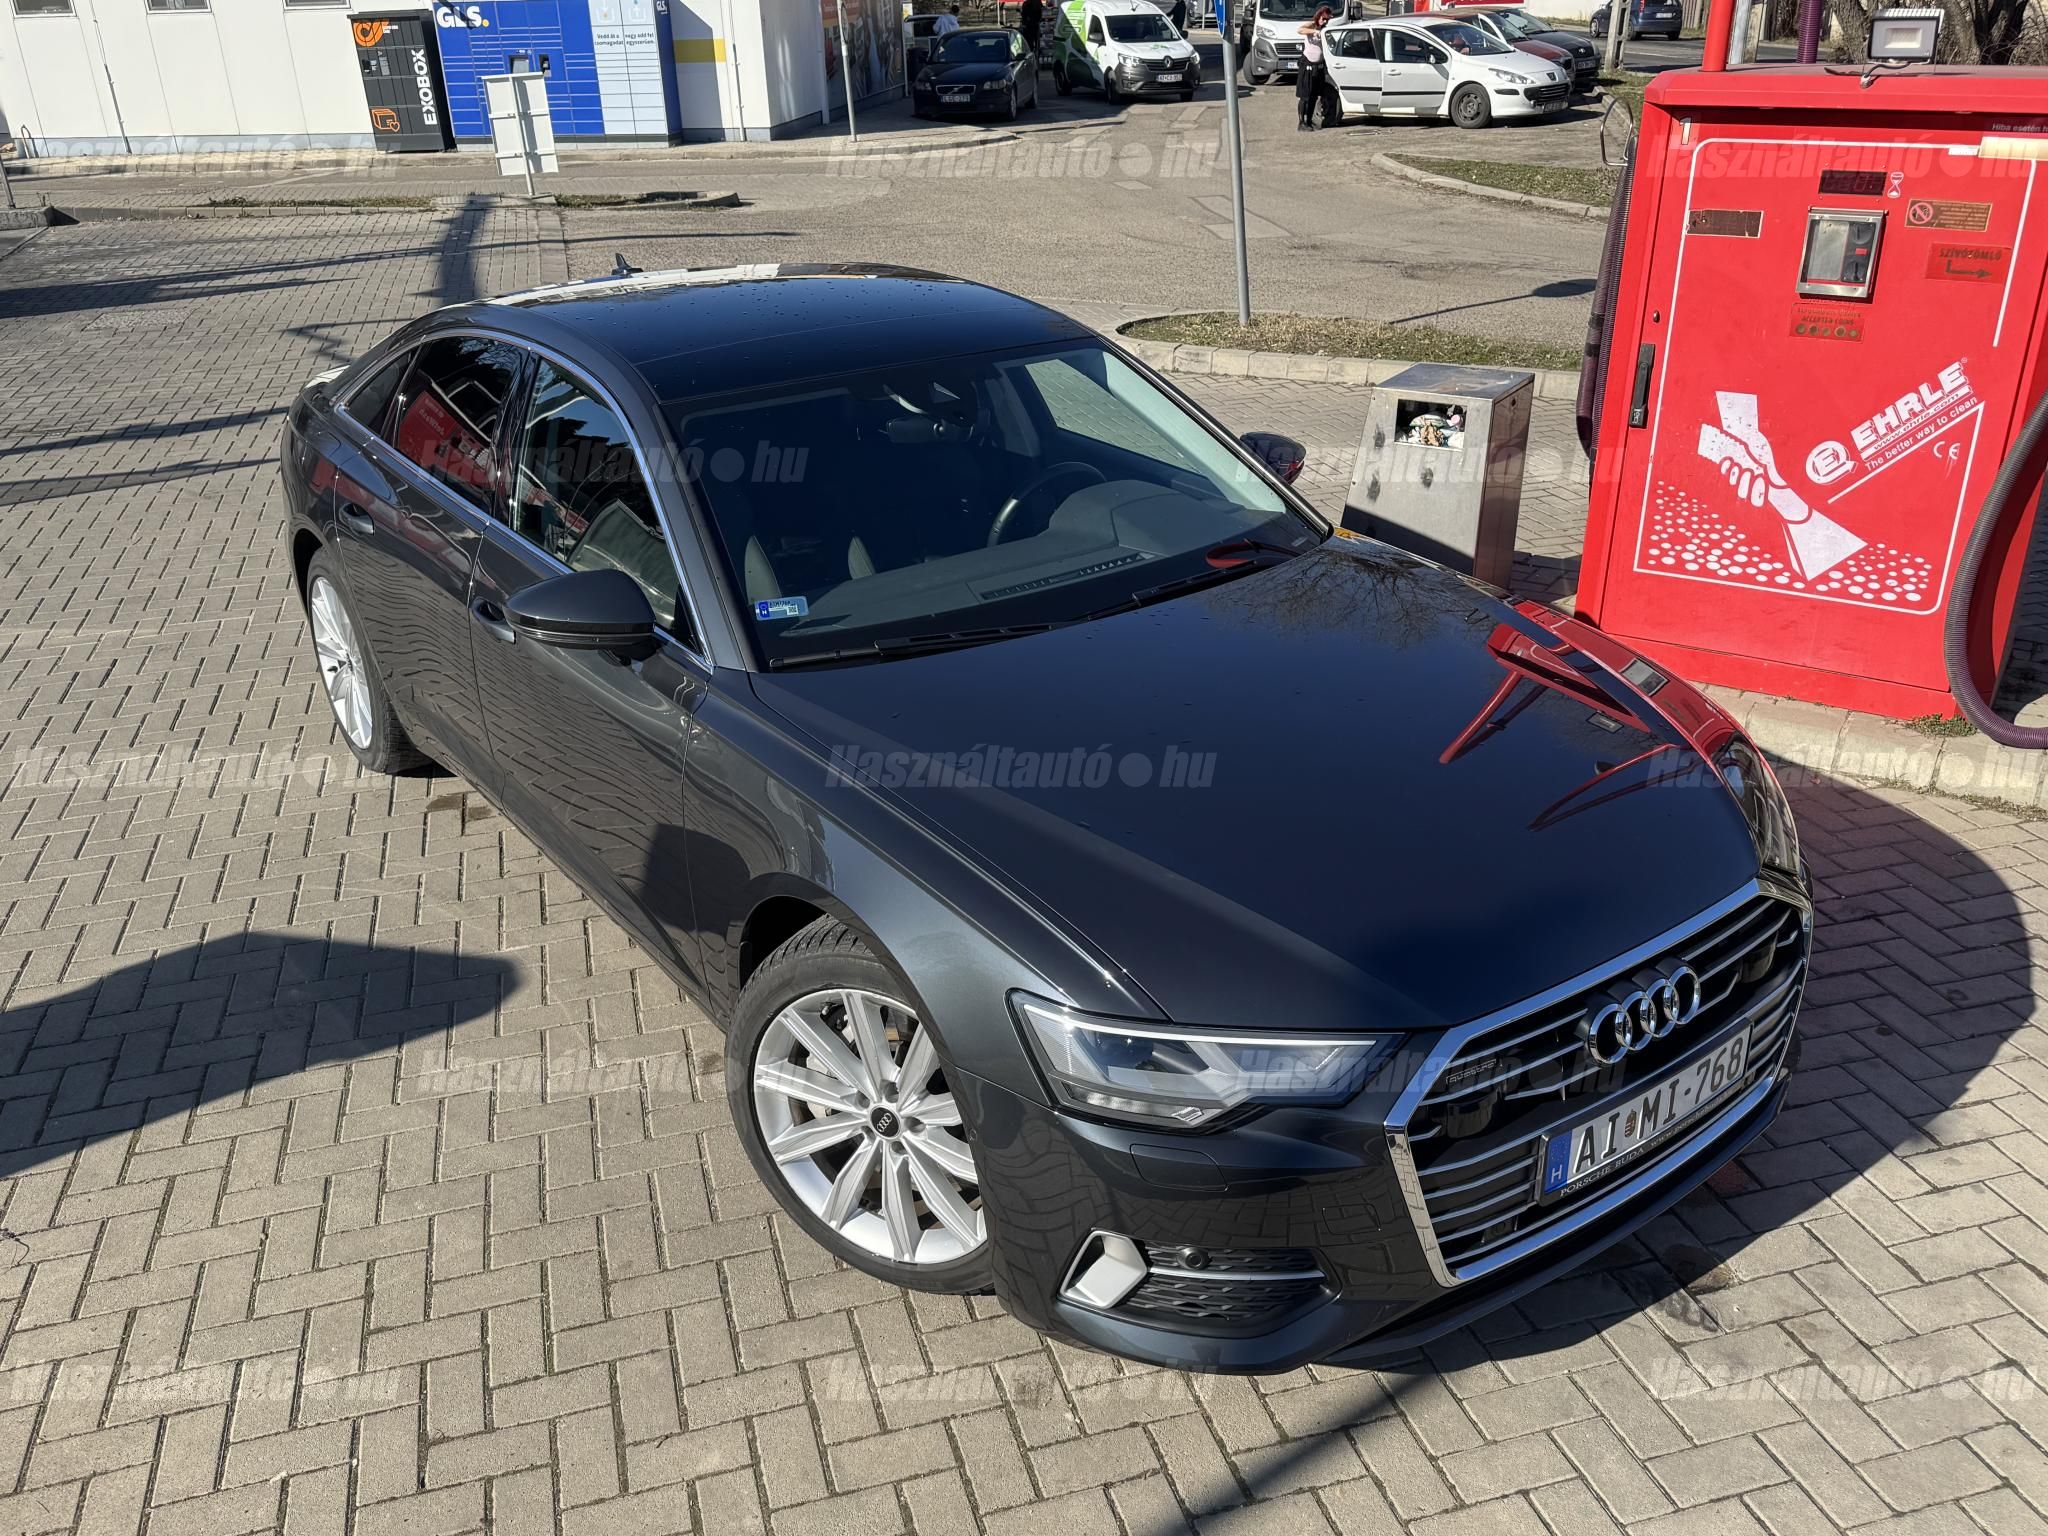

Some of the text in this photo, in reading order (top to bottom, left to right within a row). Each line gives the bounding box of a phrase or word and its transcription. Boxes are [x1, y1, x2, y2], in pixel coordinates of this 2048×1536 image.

[411, 49, 438, 125] EXOBOX
[1850, 361, 1969, 451] EHRLE
[1864, 396, 1978, 472] The better way to clean
[1873, 393, 1960, 450] www.ehrle.com
[1573, 1037, 1744, 1175] AI MI-768
[1551, 1164, 1563, 1184] H
[1560, 1165, 1612, 1197] PORSCHE
[1615, 1147, 1645, 1169] BUDA
